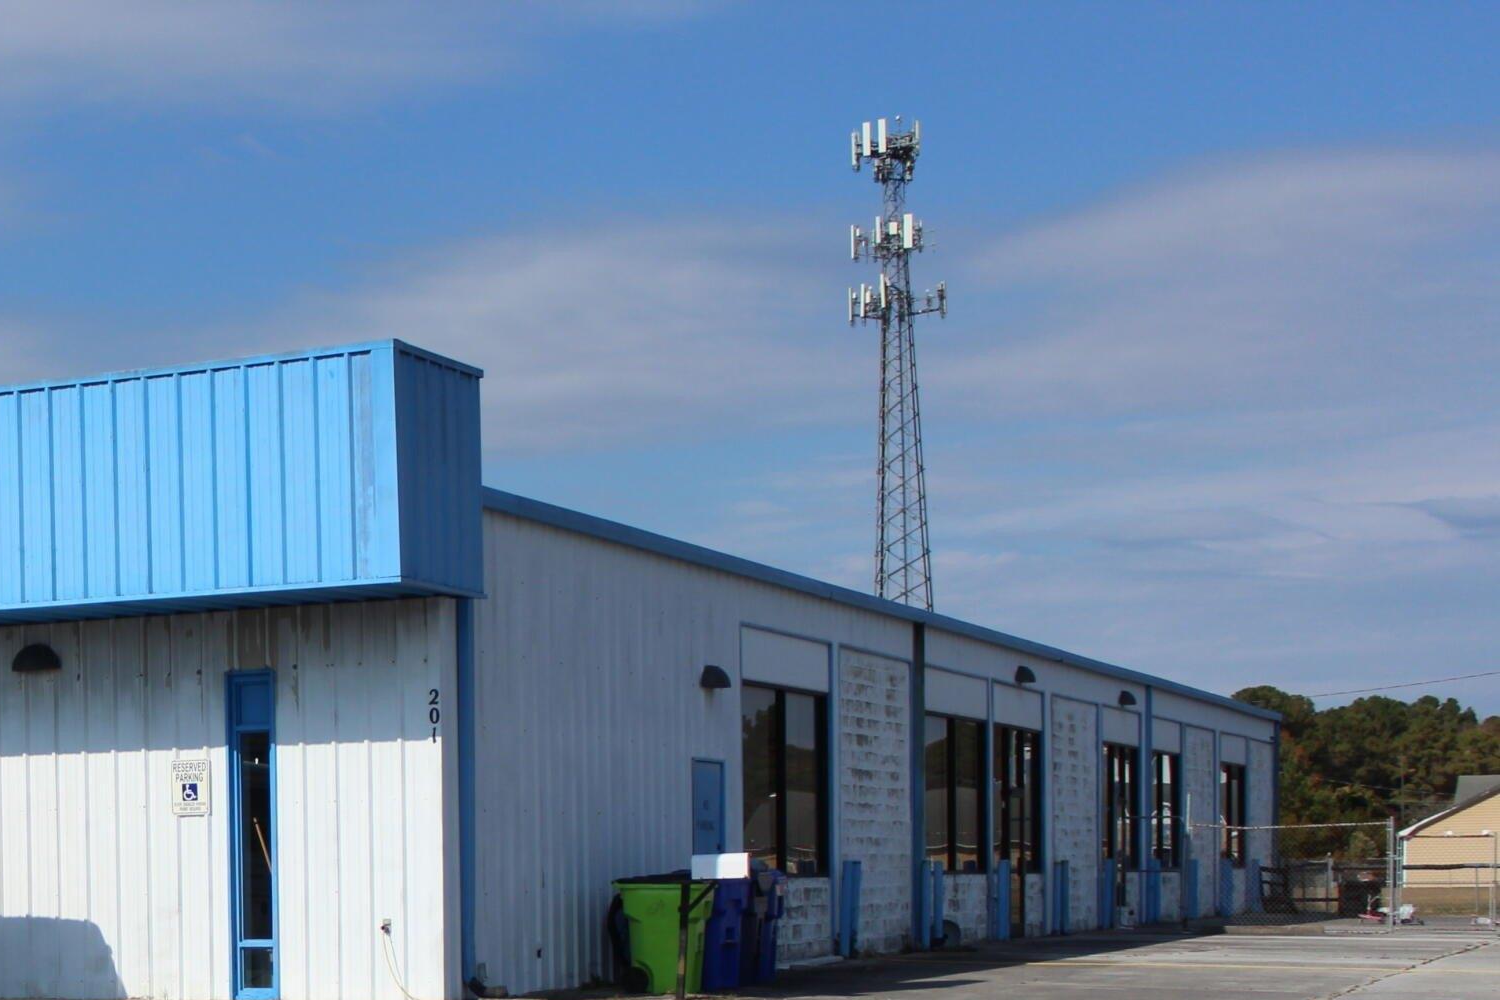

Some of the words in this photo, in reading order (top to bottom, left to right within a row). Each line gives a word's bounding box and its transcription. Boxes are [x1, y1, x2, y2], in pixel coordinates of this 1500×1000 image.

[428, 688, 440, 744] 201
[173, 762, 207, 773] RESERVED
[175, 772, 204, 783] PARKING
